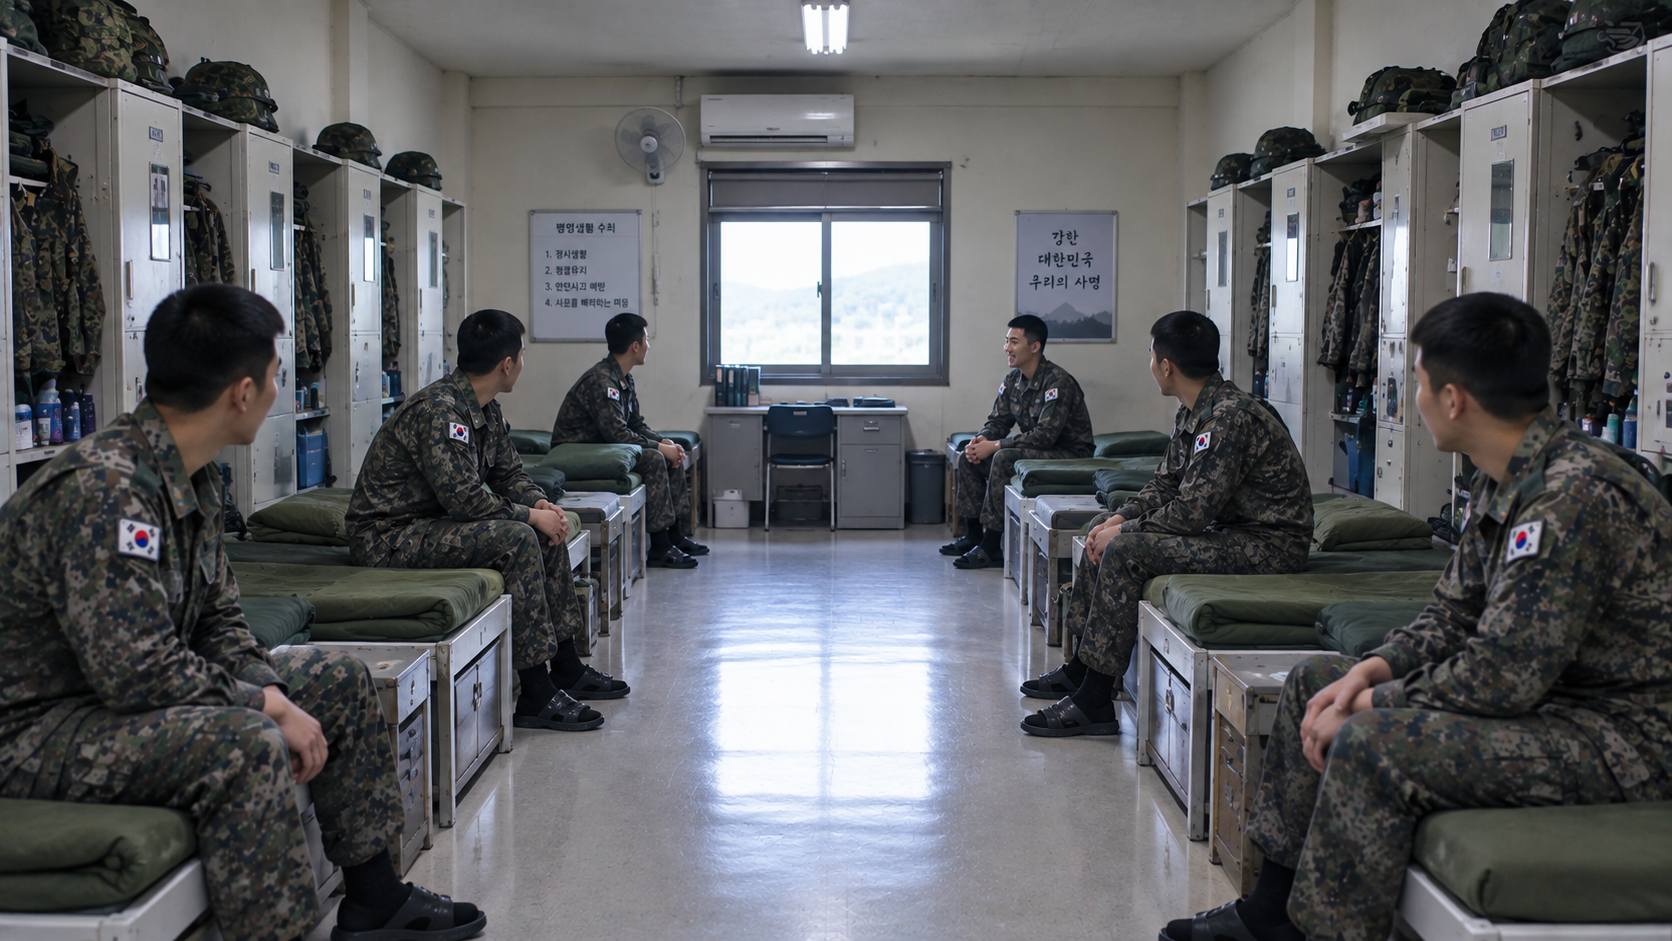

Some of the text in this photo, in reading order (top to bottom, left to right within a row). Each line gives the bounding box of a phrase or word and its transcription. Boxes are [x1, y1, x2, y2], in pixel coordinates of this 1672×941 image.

[1052, 229, 1079, 246] 강한
[545, 250, 552, 258] 1.
[1038, 251, 1093, 268] 대한민국
[545, 266, 552, 275] 2.
[545, 282, 553, 291] 3.
[545, 298, 552, 307] 4.
